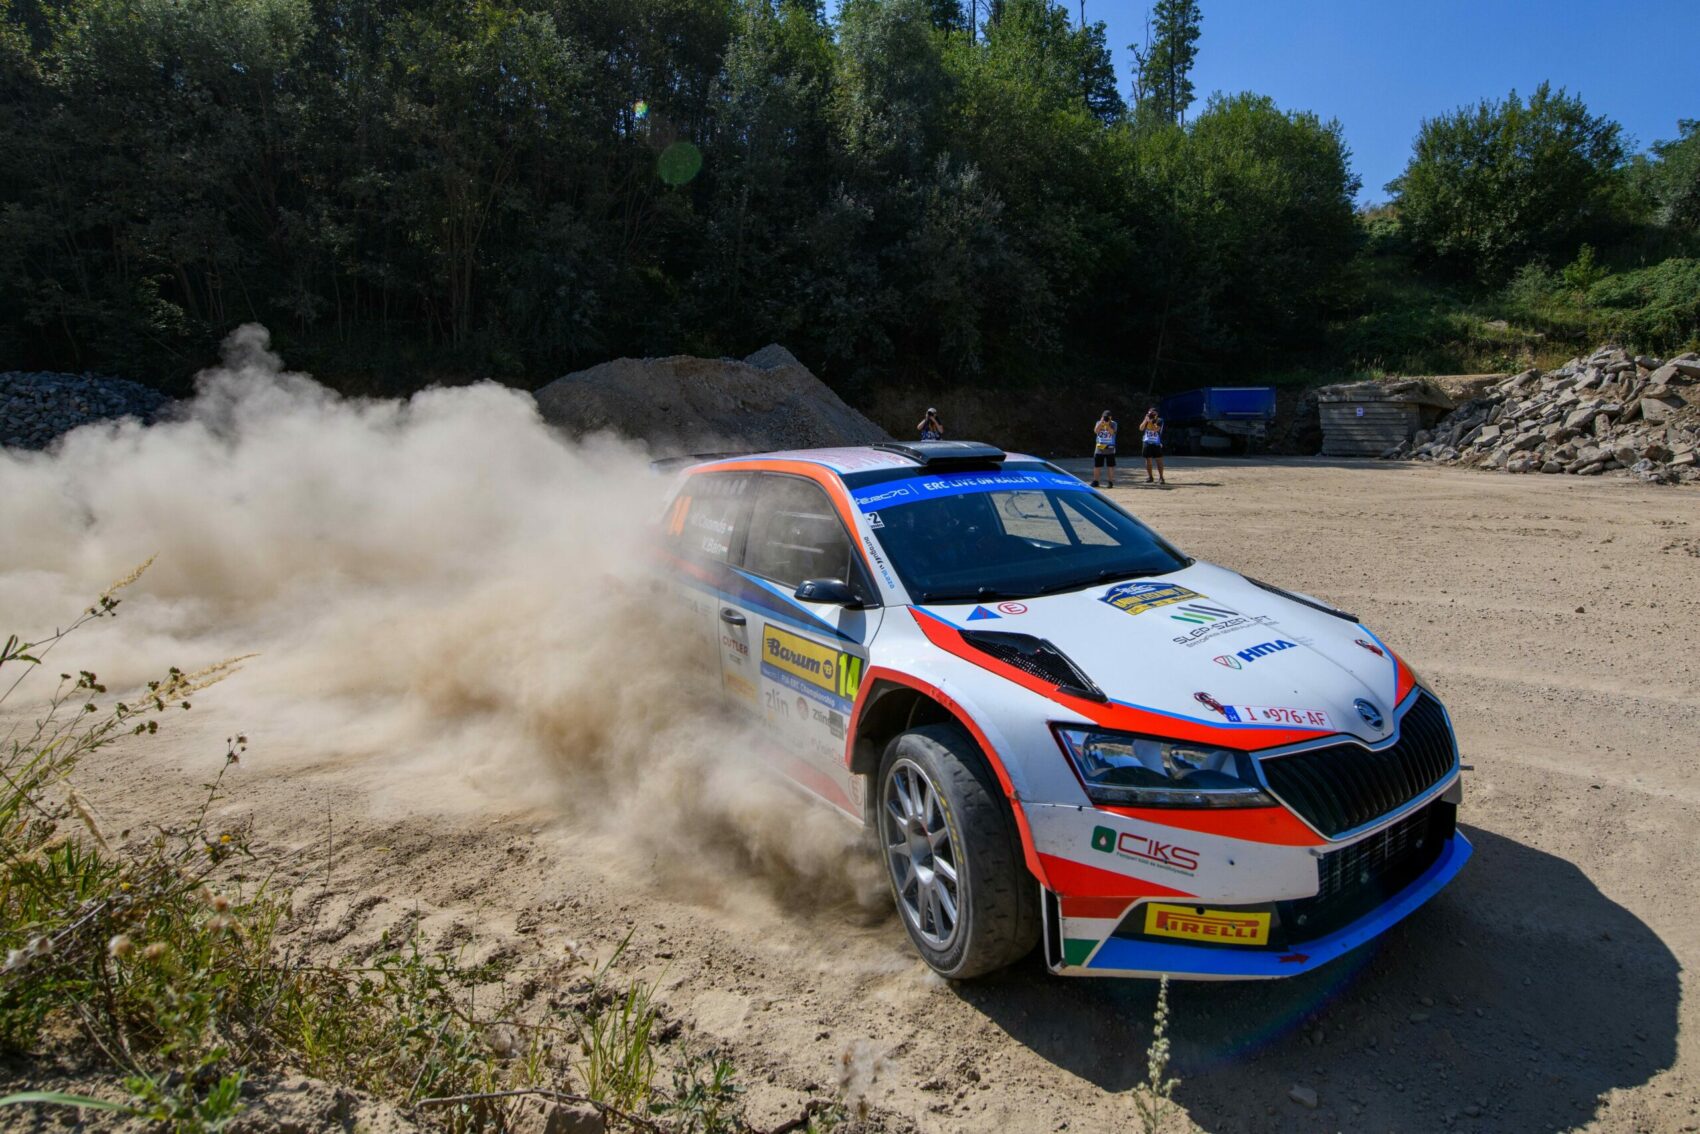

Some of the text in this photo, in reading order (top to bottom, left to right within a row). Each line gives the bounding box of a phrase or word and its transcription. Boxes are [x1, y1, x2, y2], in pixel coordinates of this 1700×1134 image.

[923, 476, 1040, 491] ERC LIVE ON RALLY.TV
[766, 638, 821, 675] Barum
[839, 653, 861, 702] 14
[1117, 832, 1200, 871] CIKS
[1156, 910, 1260, 938] PIRELLI
